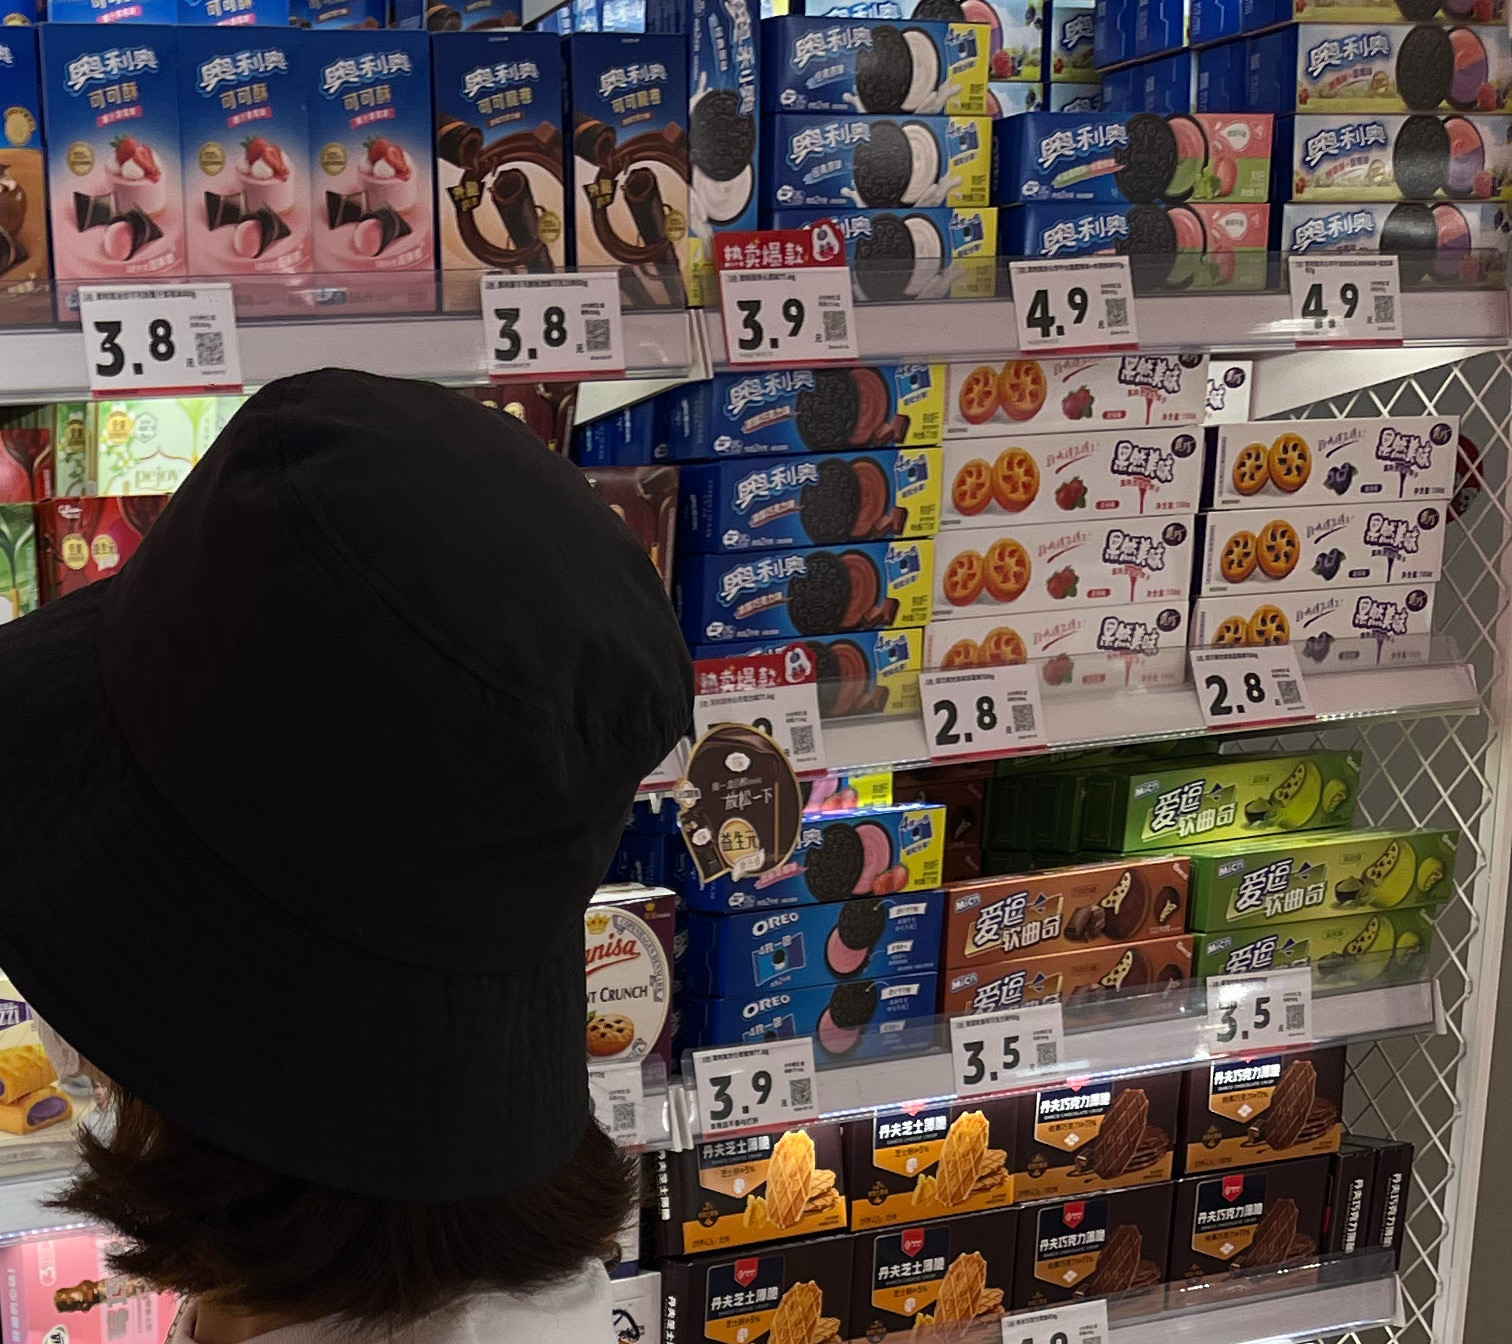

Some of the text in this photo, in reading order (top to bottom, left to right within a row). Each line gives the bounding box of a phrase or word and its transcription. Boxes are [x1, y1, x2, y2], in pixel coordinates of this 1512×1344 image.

[792, 26, 874, 66] 奥利奥
[1307, 32, 1390, 78] 奥利奥
[1040, 123, 1129, 167] 奥利奥
[494, 306, 568, 361] 3.8
[737, 298, 805, 350] 3.9
[1026, 288, 1088, 337] 4.9
[94, 319, 174, 376] 3.8
[1205, 672, 1265, 716] 2.8
[933, 695, 998, 745] 2.8
[752, 911, 799, 937] OREO
[1002, 918, 1061, 952] 软曲奇
[600, 985, 648, 1003] CRUNCH
[1216, 996, 1271, 1043] 3.5
[963, 1035, 1020, 1085] 3.5
[709, 1070, 773, 1121] 3.9
